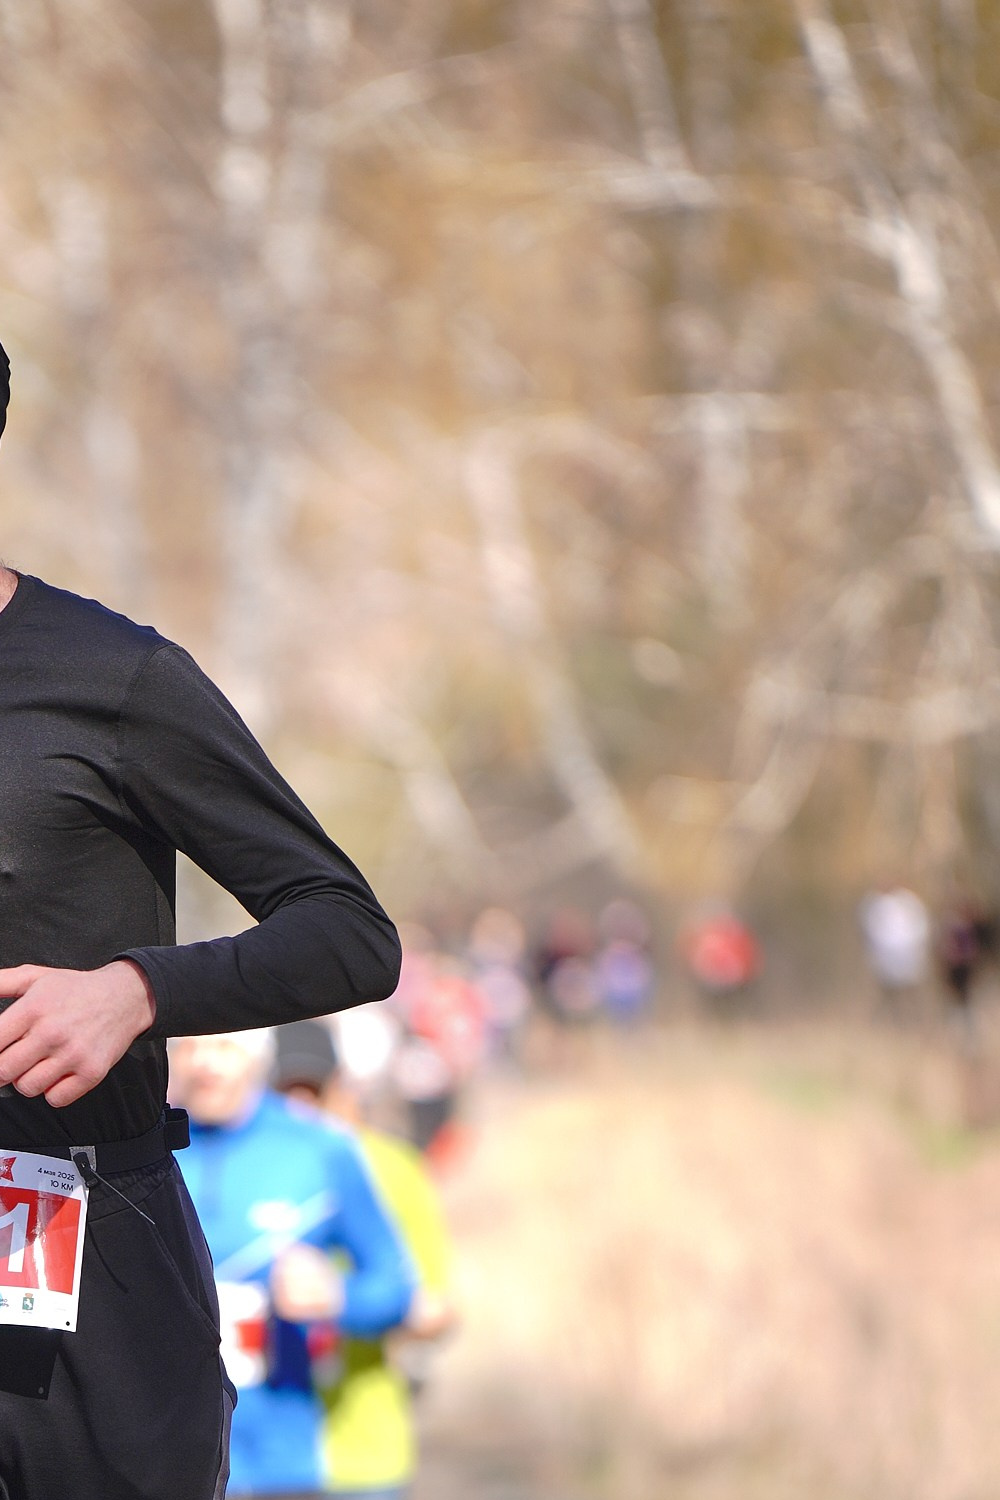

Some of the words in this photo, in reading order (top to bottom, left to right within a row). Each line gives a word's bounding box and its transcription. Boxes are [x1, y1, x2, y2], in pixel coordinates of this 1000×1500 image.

[57, 1171, 75, 1181] 2025
[50, 1179, 60, 1188] 10
[61, 1182, 74, 1192] КМ
